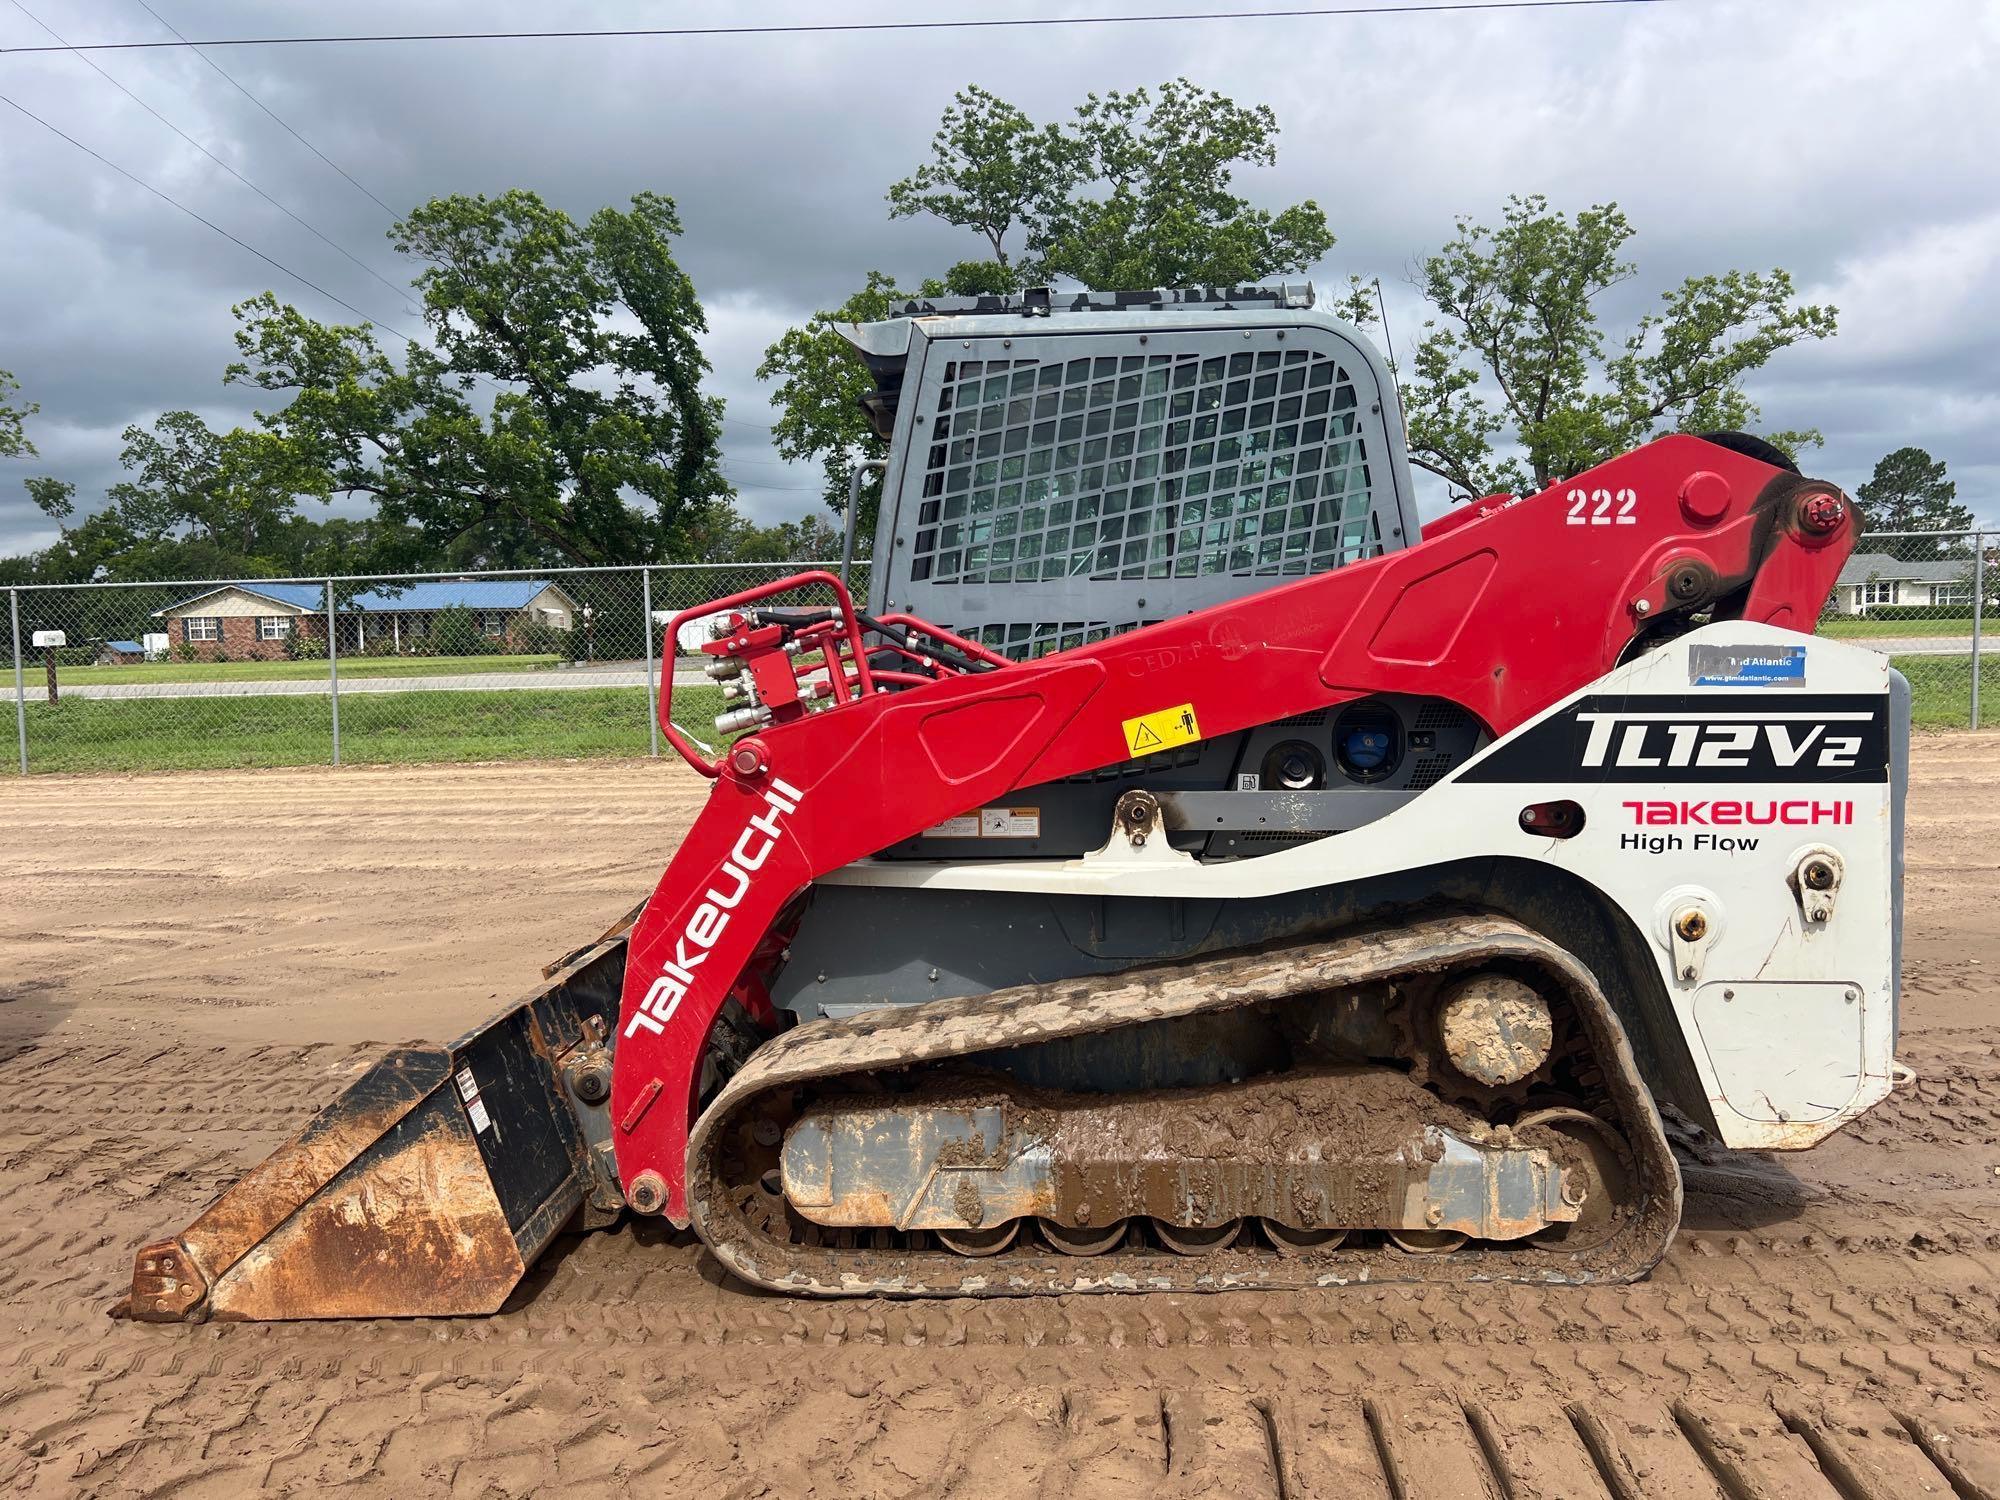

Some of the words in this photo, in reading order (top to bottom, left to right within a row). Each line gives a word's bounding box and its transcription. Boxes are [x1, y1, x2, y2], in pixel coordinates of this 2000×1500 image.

[1567, 489, 1637, 525] 222
[1751, 657, 1792, 666] Atlantic
[1576, 712, 1875, 767] TL12V2
[1620, 833, 1683, 855] High
[1693, 833, 1760, 851] Flow
